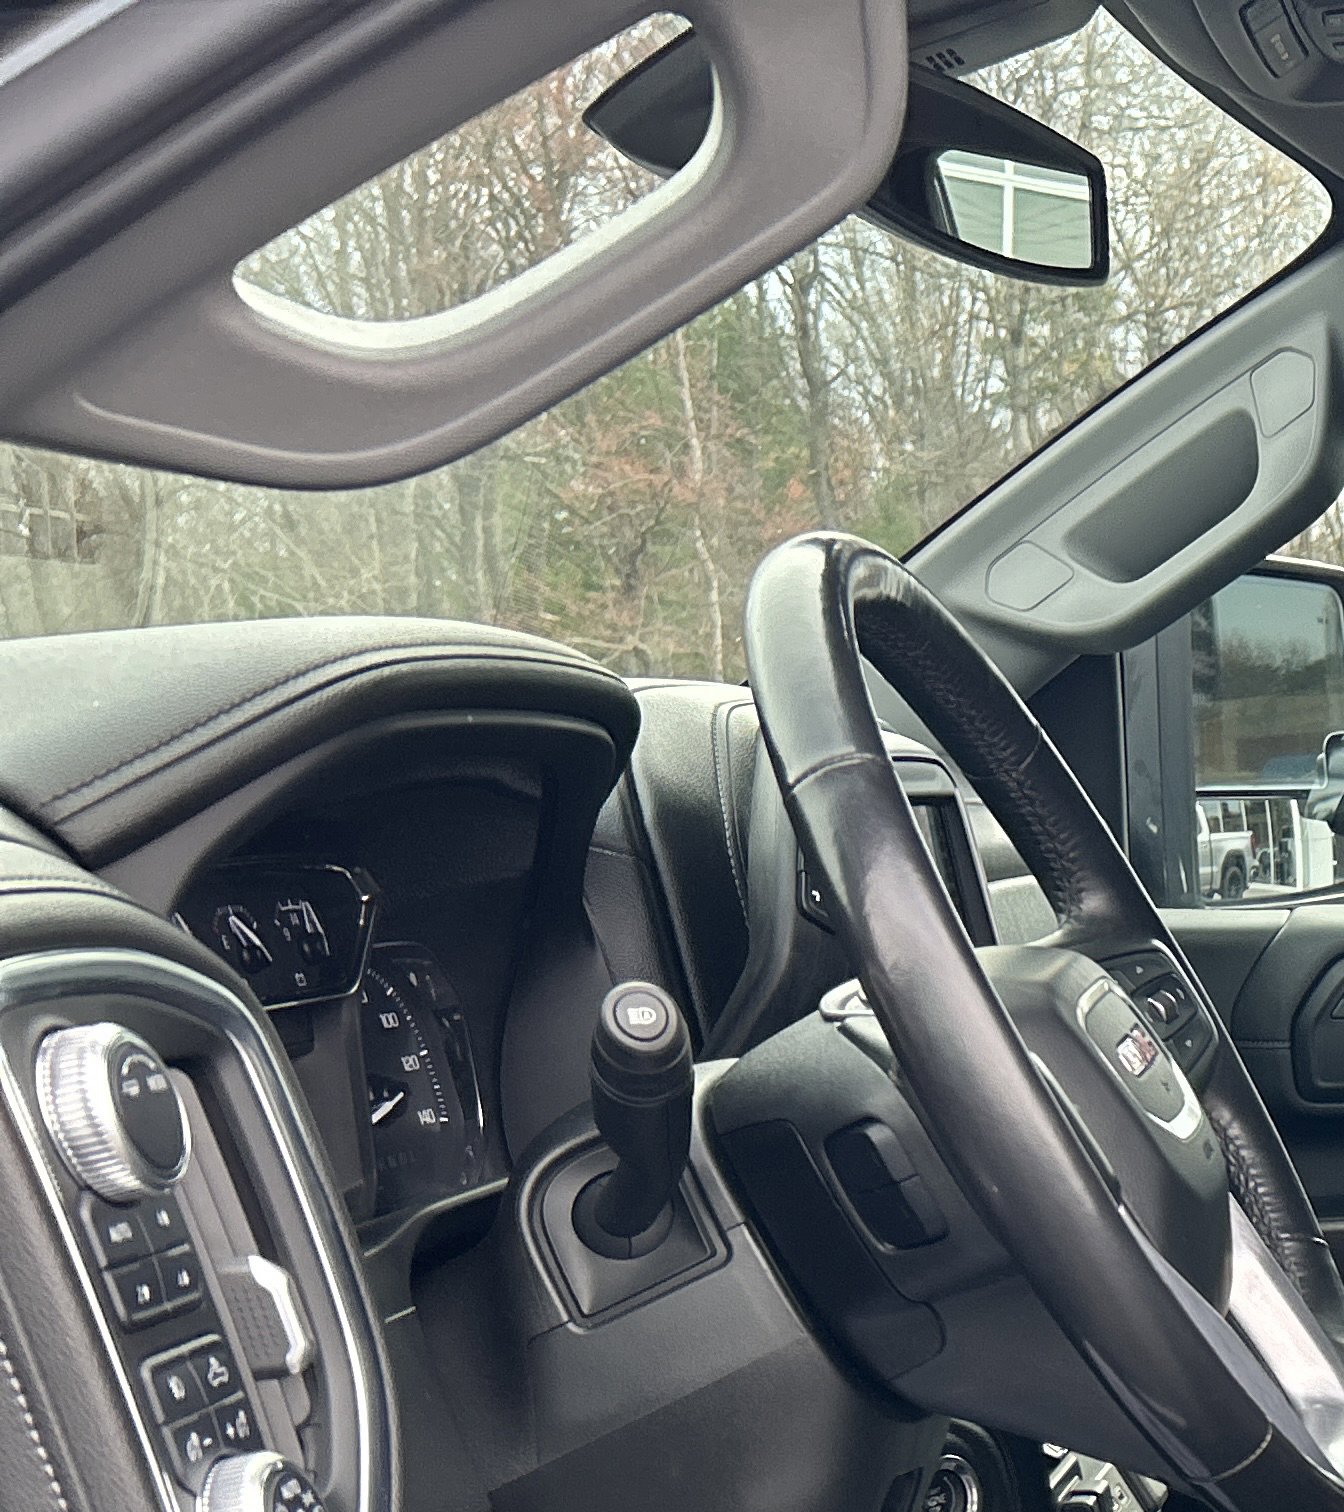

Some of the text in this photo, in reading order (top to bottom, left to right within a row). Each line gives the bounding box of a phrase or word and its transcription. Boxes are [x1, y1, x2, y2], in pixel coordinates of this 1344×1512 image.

[380, 1012, 399, 1028] 100
[401, 1055, 420, 1072] 120
[417, 1108, 436, 1126] 140
